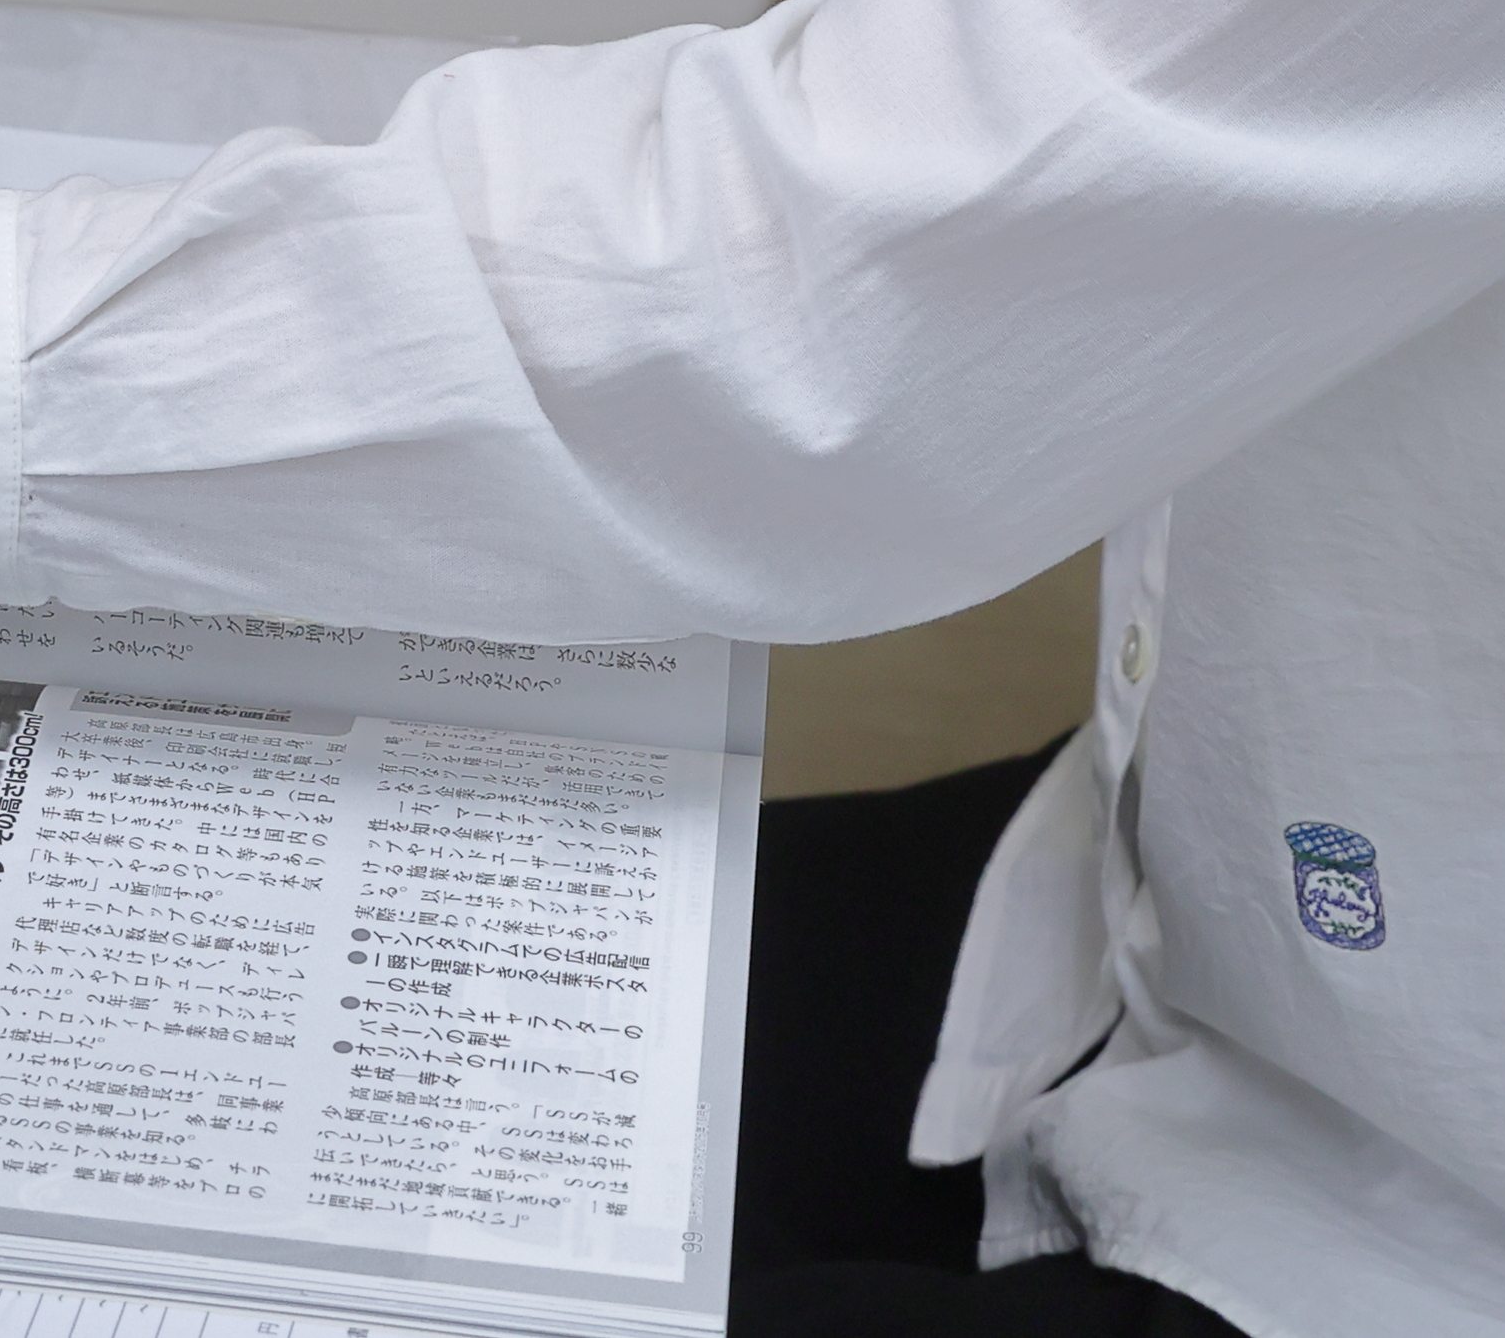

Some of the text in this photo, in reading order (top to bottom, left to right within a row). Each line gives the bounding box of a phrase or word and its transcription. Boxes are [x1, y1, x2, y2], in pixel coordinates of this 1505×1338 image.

[91, 636, 195, 664] いるそうだ。
[396, 665, 564, 694] いといえるだろう。
[56, 746, 340, 787] デザイナーとなる。時代に合
[379, 763, 665, 801] 有力なツールだが、活用できて
[381, 747, 665, 785] メージを確立し、集客のための
[377, 779, 630, 815] いない企業もまだまだ多い。
[40, 806, 328, 847] 手掛けてきた。中には国内の
[368, 818, 659, 859] 性を知る企業では、イメージア
[398, 801, 662, 839] 一方、マーケティングの重要
[35, 828, 325, 868] 有名企業のカタログ等もあり
[368, 839, 657, 881] ップやエンドユーザーに訴えか
[26, 871, 223, 902] で好き」と断言する。
[29, 847, 323, 892] 「デザインやものづくりが本気
[362, 860, 655, 901] ける施策を積極的に展開して
[43, 897, 316, 936] キャリアアップのために広告
[360, 882, 654, 924] いる。以下はポップジャパンが
[15, 916, 310, 957] 代理店など数度の転職を経て、
[354, 905, 619, 943] 実際に関わった案件である。
[11, 938, 305, 982] デザインだけでなく、ディレ
[373, 927, 650, 970] インスタグラムでの広告配信
[6, 962, 304, 1003] クションやプロデュースも行う
[366, 977, 453, 998] ーの作成
[375, 951, 648, 993] 一瞬で理解できる企業ポスタ
[360, 1017, 513, 1049] バルーンの制作
[361, 996, 643, 1040] オリジナルキャラクターの
[356, 1040, 639, 1084] オリジナルのユニフォームの
[317, 1127, 632, 1172] うとしている。その変化をお手
[308, 1193, 532, 1228] に開拓していきたい」。
[310, 1170, 627, 1217] まだまだ地域貢献できる。一緒
[681, 1232, 705, 1255] 99
